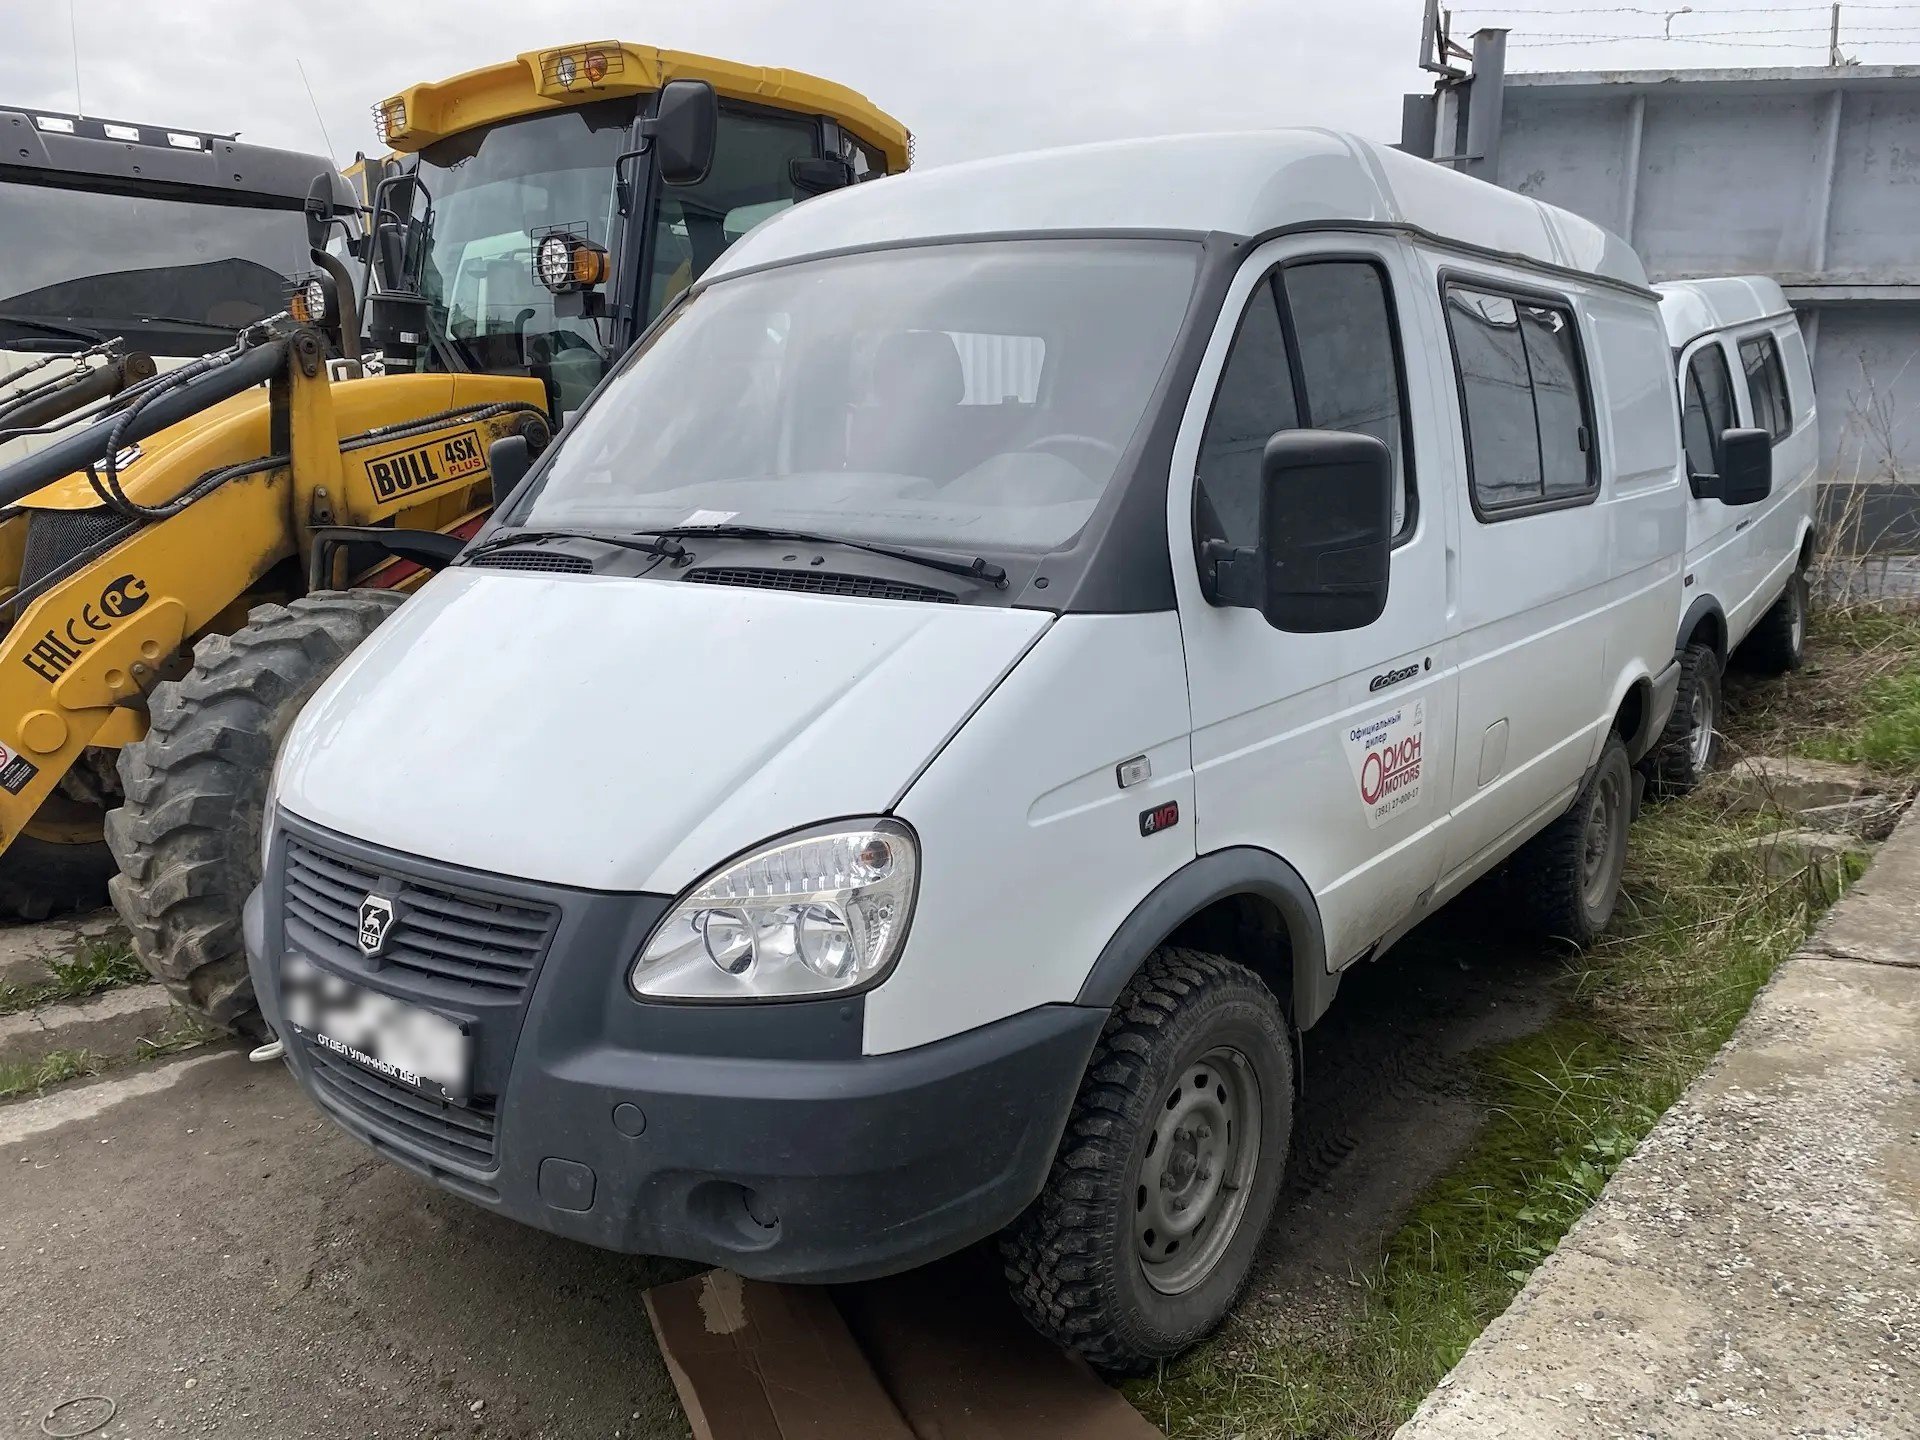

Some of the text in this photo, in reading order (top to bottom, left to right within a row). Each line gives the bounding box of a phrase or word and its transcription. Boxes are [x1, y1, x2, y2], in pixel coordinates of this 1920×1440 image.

[373, 436, 477, 497] BULL 4SX
[449, 458, 481, 475] PLUS
[1350, 710, 1402, 741] Официальный
[1365, 732, 1387, 750] дилер
[1384, 765, 1420, 796] MOTORS
[1144, 804, 1177, 831] 4WD
[361, 933, 378, 947] ГАЗ
[317, 1033, 421, 1088] ОТДЕЛ УЛИЧНЫХ ДЕЛ
